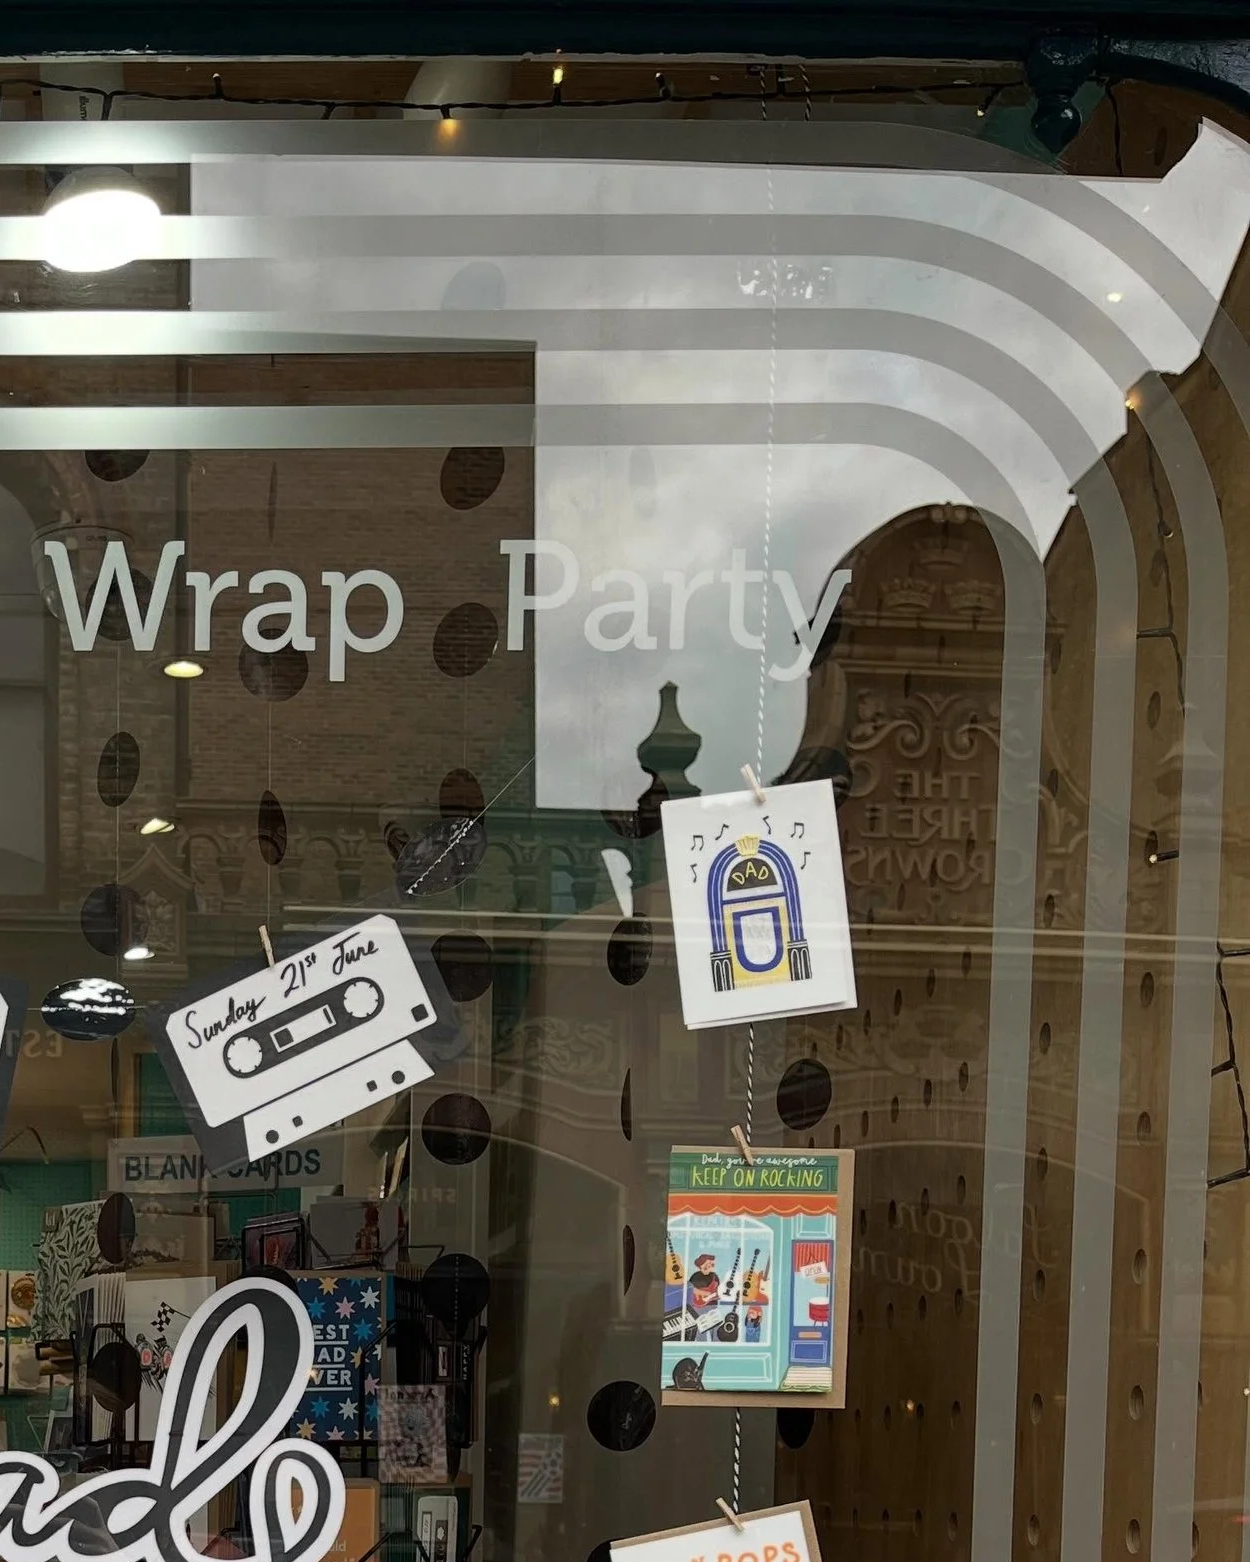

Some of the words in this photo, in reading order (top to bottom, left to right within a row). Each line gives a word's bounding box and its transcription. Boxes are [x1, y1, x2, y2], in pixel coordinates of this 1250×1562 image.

[44, 540, 405, 682] Wrap
[499, 538, 853, 683] Party
[731, 861, 769, 885] DAD
[185, 995, 266, 1049] Sunday
[280, 953, 317, 998] 21st
[333, 931, 379, 975] June
[125, 1153, 217, 1183] BLANK
[702, 1154, 723, 1165] Dad,
[766, 1157, 817, 1168] awesome
[692, 1167, 726, 1187] KEEP
[734, 1168, 755, 1187] ON
[760, 1168, 823, 1187] ROCKING
[314, 1324, 350, 1340] EST
[317, 1347, 346, 1363] AD
